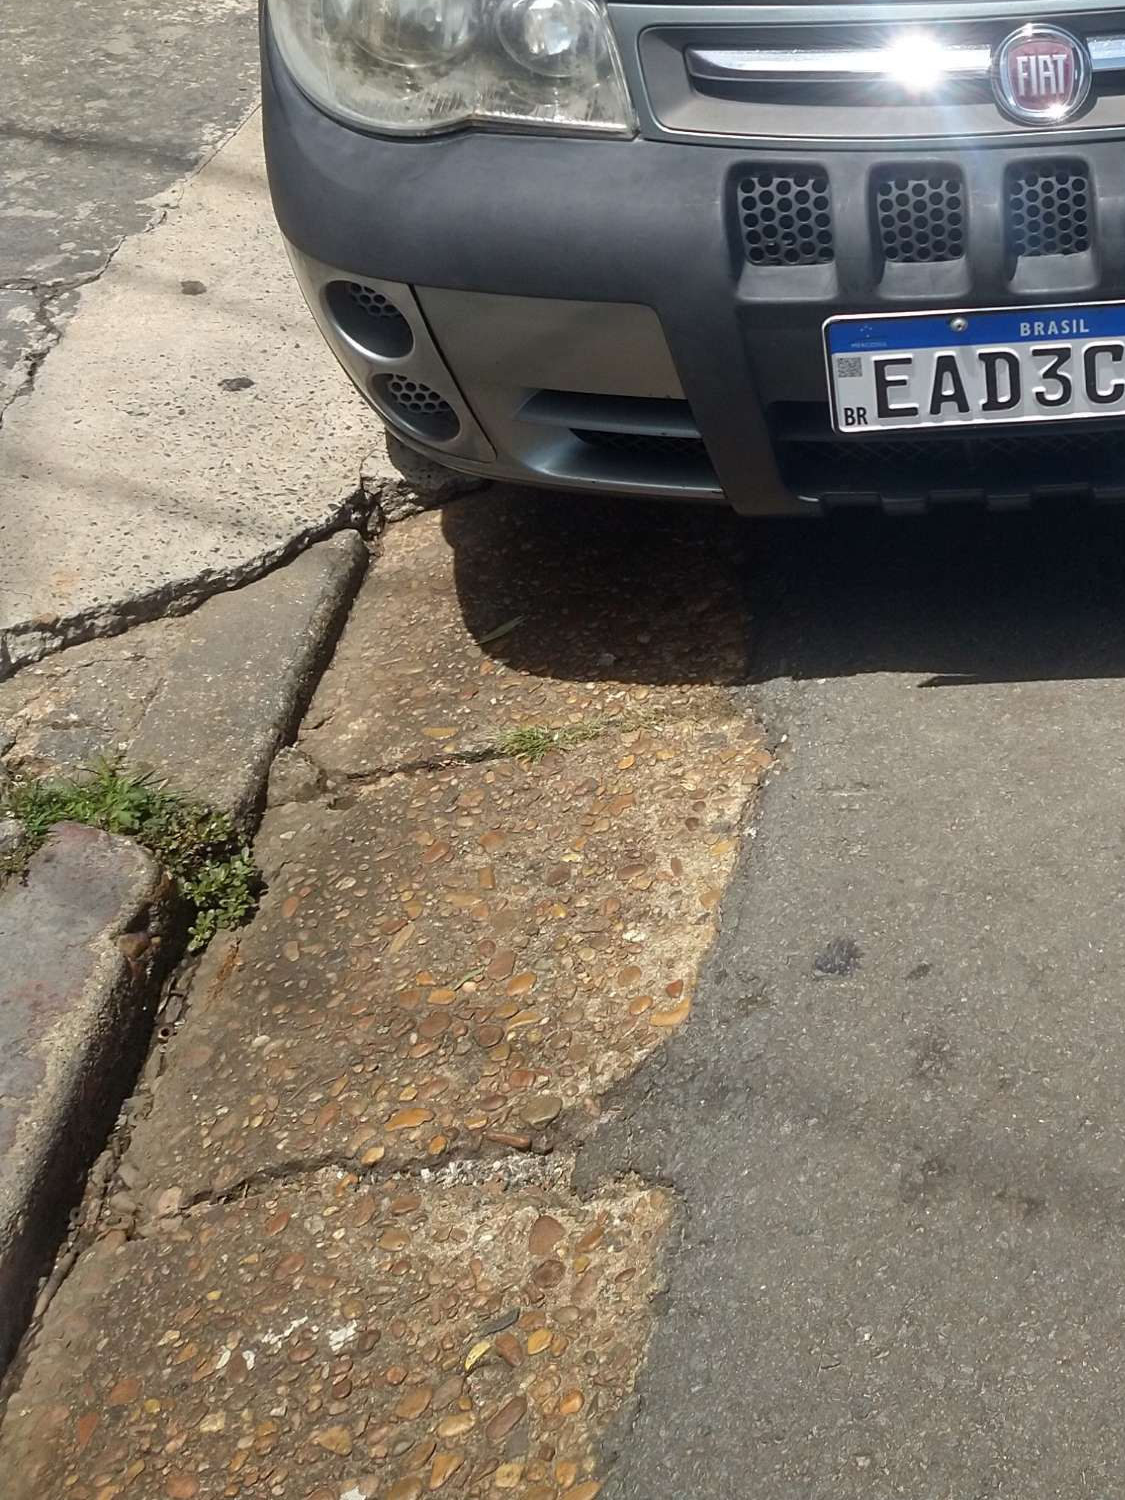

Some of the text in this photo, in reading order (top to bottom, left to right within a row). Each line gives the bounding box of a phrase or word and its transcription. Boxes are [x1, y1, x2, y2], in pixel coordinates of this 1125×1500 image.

[1016, 53, 1068, 97] FIAT
[1020, 318, 1090, 336] BRASIL
[844, 407, 869, 426] BR
